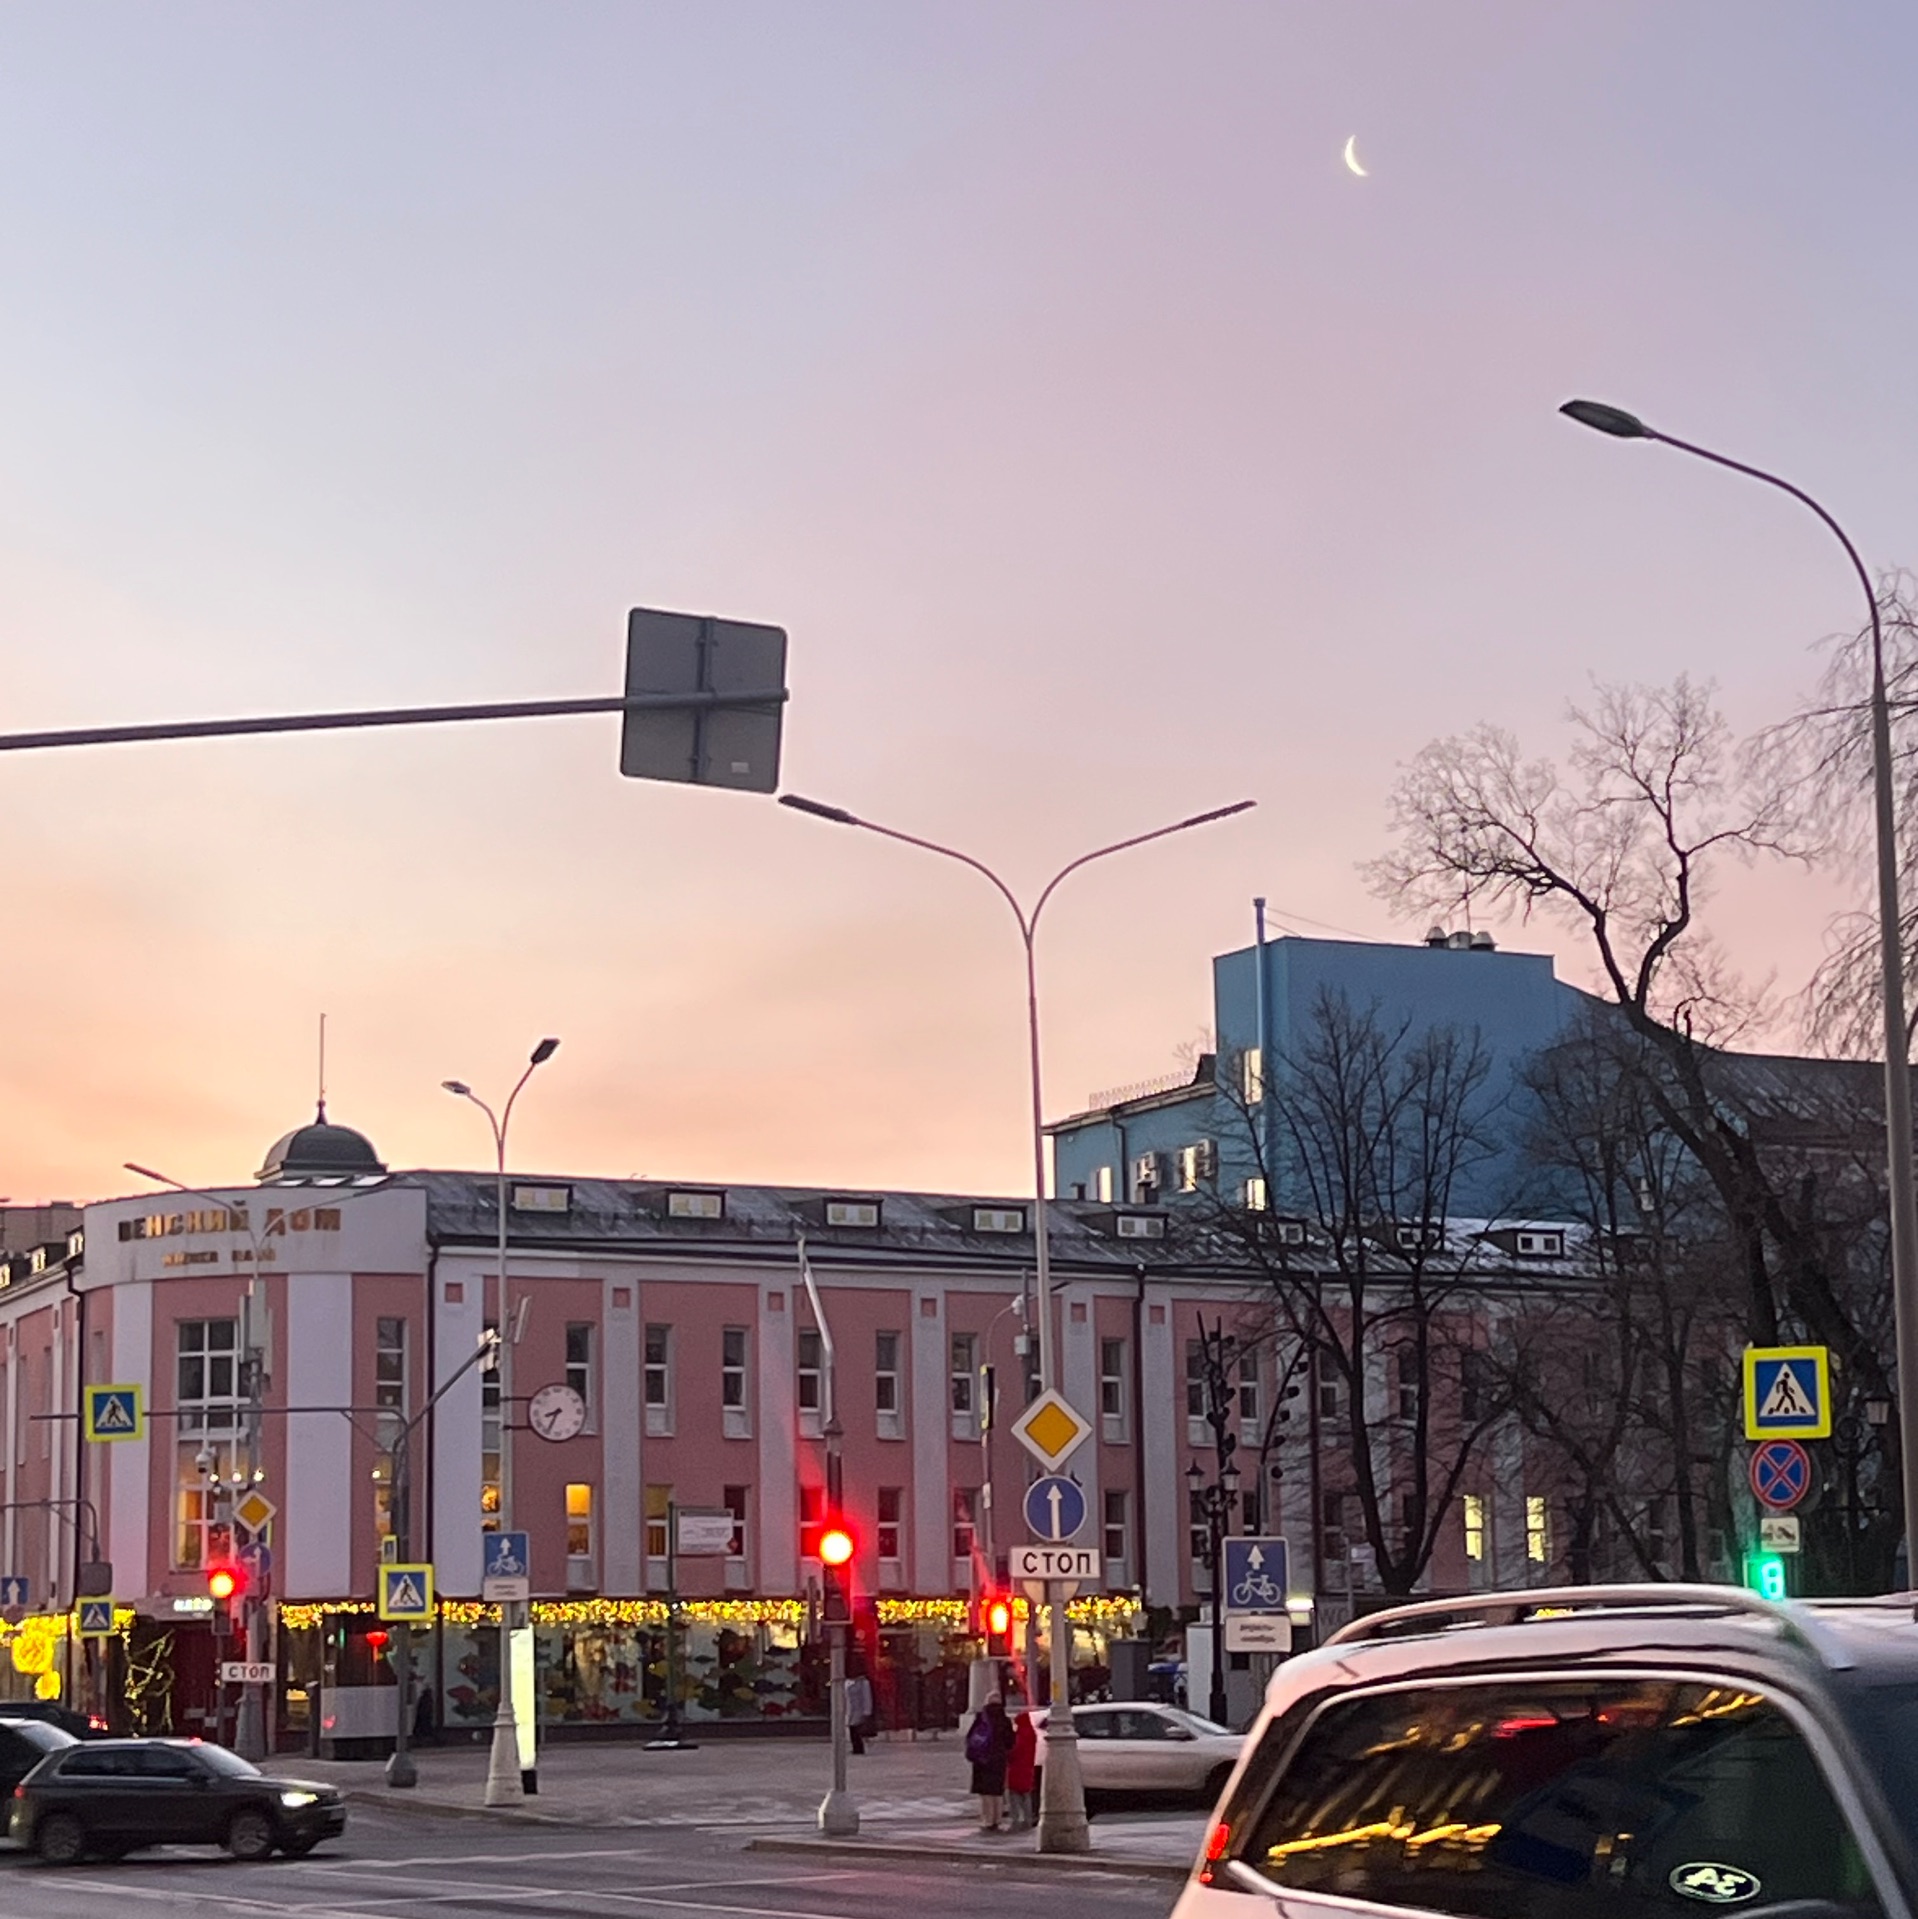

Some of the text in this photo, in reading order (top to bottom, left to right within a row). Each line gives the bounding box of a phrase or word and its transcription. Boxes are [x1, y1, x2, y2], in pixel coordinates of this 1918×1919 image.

[264, 1208, 341, 1236] ДОМ
[1022, 1552, 1091, 1574] СТОП
[228, 1665, 270, 1679] СТОП
